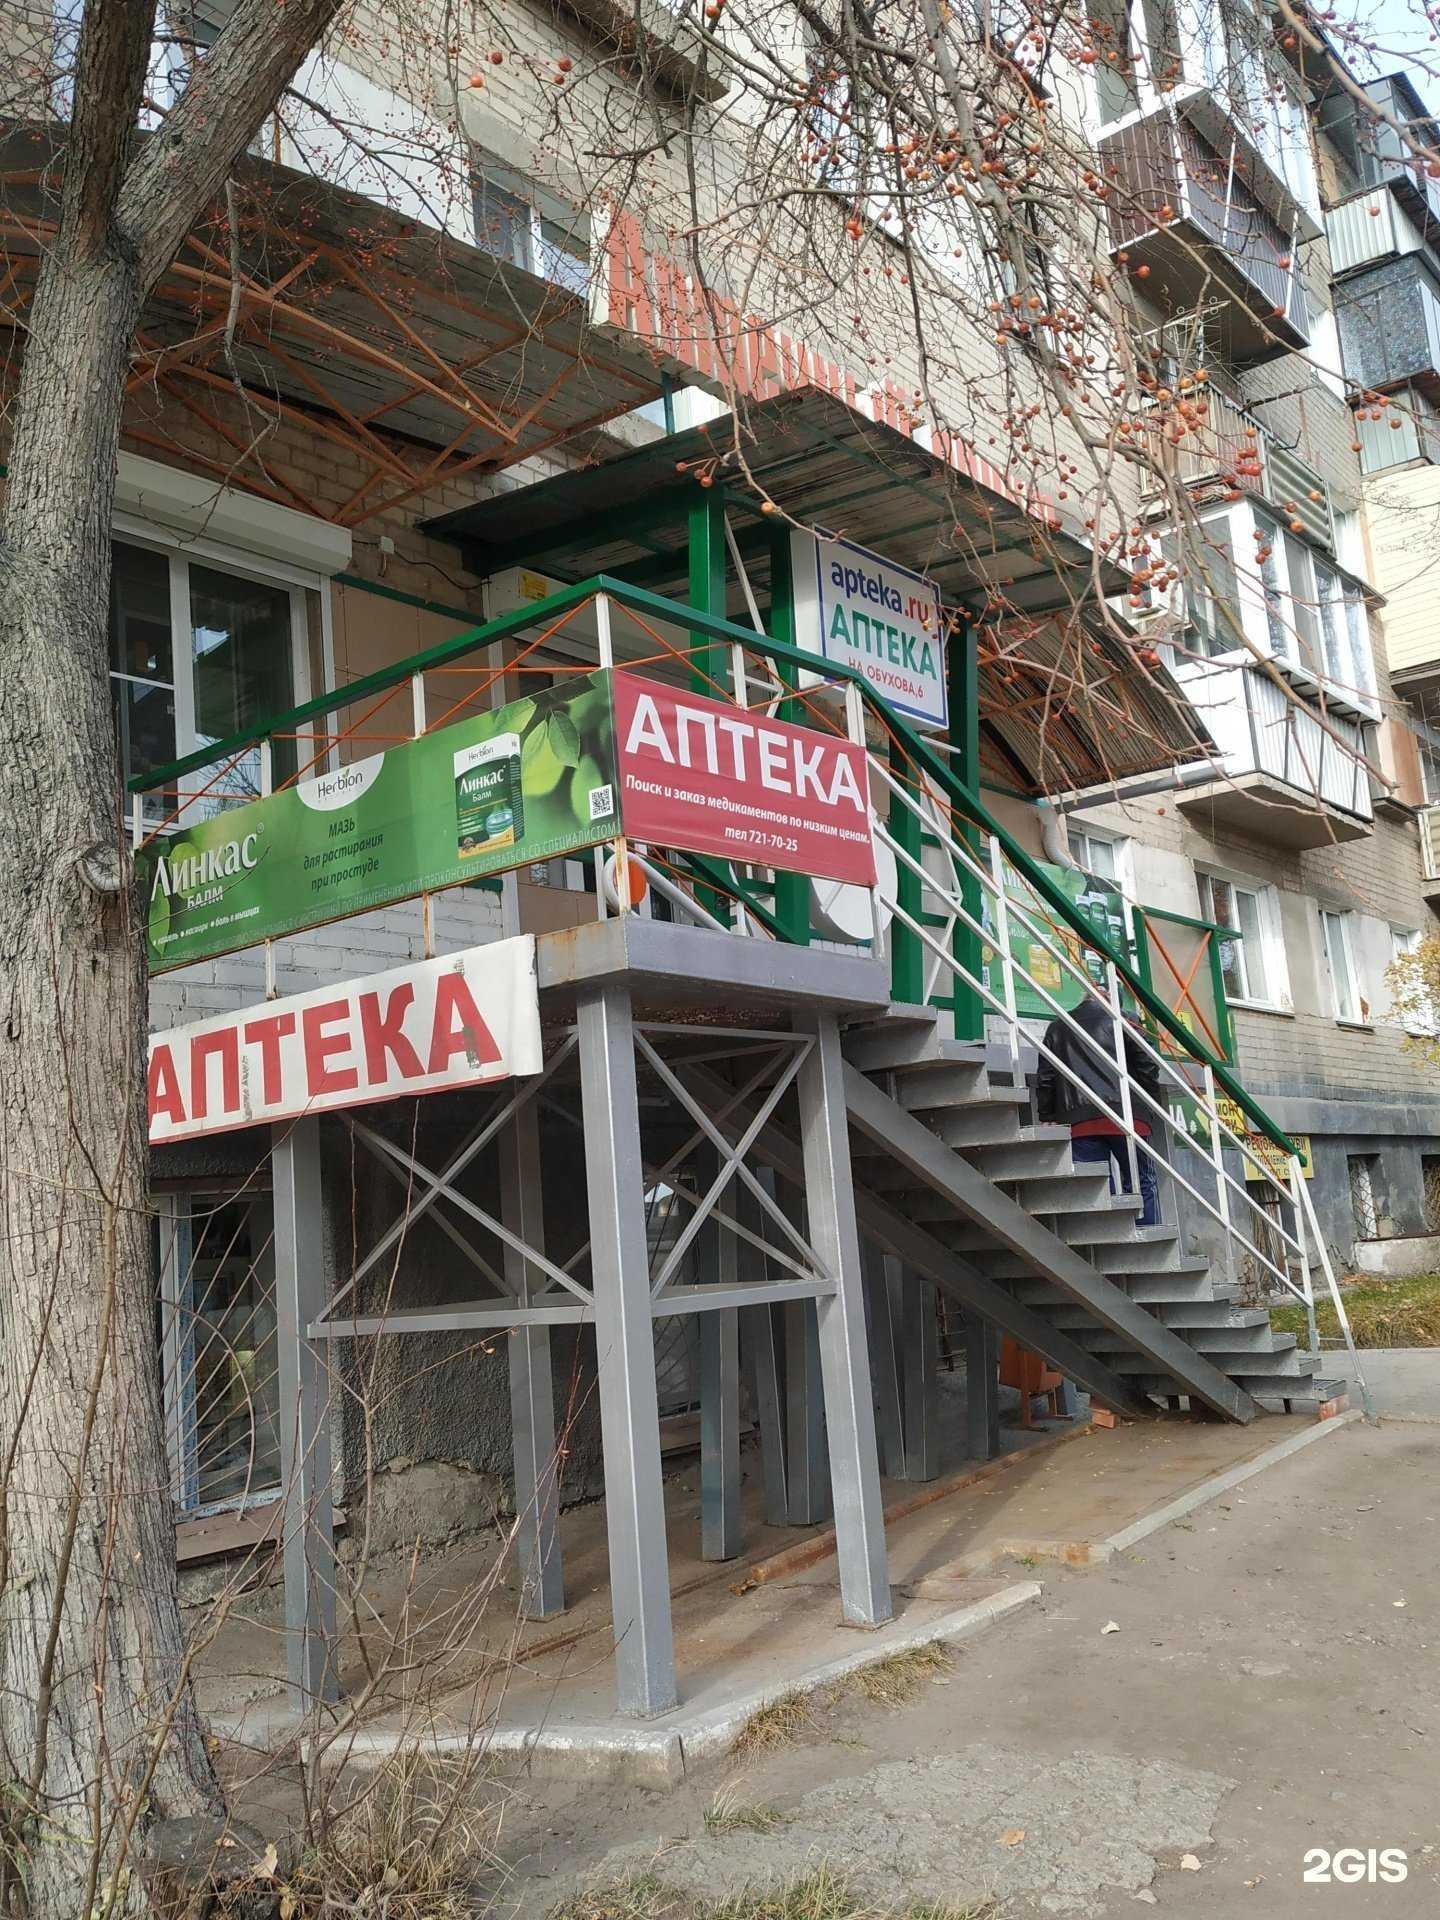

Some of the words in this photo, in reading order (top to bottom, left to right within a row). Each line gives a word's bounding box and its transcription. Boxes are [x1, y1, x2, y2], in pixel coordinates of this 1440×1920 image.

[831, 561, 928, 623] apteka.ru
[830, 603, 937, 680] АПТЕКА
[849, 657, 863, 675] НА
[468, 746, 494, 761] Herbion
[625, 694, 866, 812] АПТЕКА
[317, 772, 363, 798] Herbion
[460, 768, 504, 795] Линкас
[472, 790, 492, 802] Балм
[626, 775, 662, 795] Поиск
[664, 786, 672, 797] и
[673, 788, 706, 805] заказ
[708, 795, 788, 824] медикаментов
[790, 815, 802, 827] по
[803, 818, 843, 836] низким
[839, 828, 871, 844] ценам.
[328, 818, 356, 838] МАЗЬ
[725, 827, 747, 841] тел
[749, 829, 798, 851] 721-70-25
[151, 833, 258, 901] Линкас
[303, 855, 321, 870] для
[322, 833, 384, 868] растирания
[311, 874, 329, 893] при
[331, 858, 380, 886] простуде
[149, 971, 502, 1124] АПТЕКА
